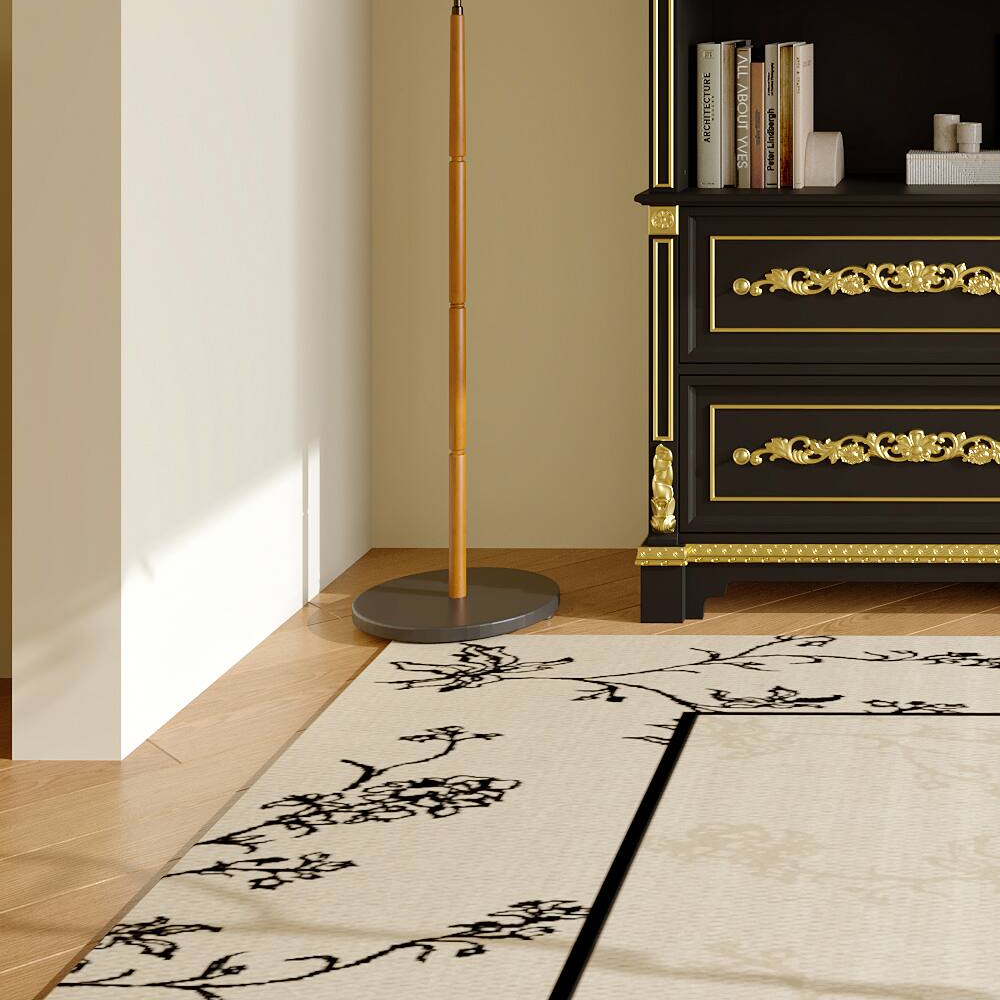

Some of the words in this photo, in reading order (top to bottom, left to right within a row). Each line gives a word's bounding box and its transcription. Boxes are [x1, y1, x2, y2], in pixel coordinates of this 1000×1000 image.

[737, 54, 748, 79] ALL
[703, 72, 711, 143] ARCHITECTURE
[737, 83, 748, 129] ABOUT
[766, 108, 776, 147] Lindbergh
[737, 136, 748, 169] YVES
[766, 148, 775, 171] Peter
